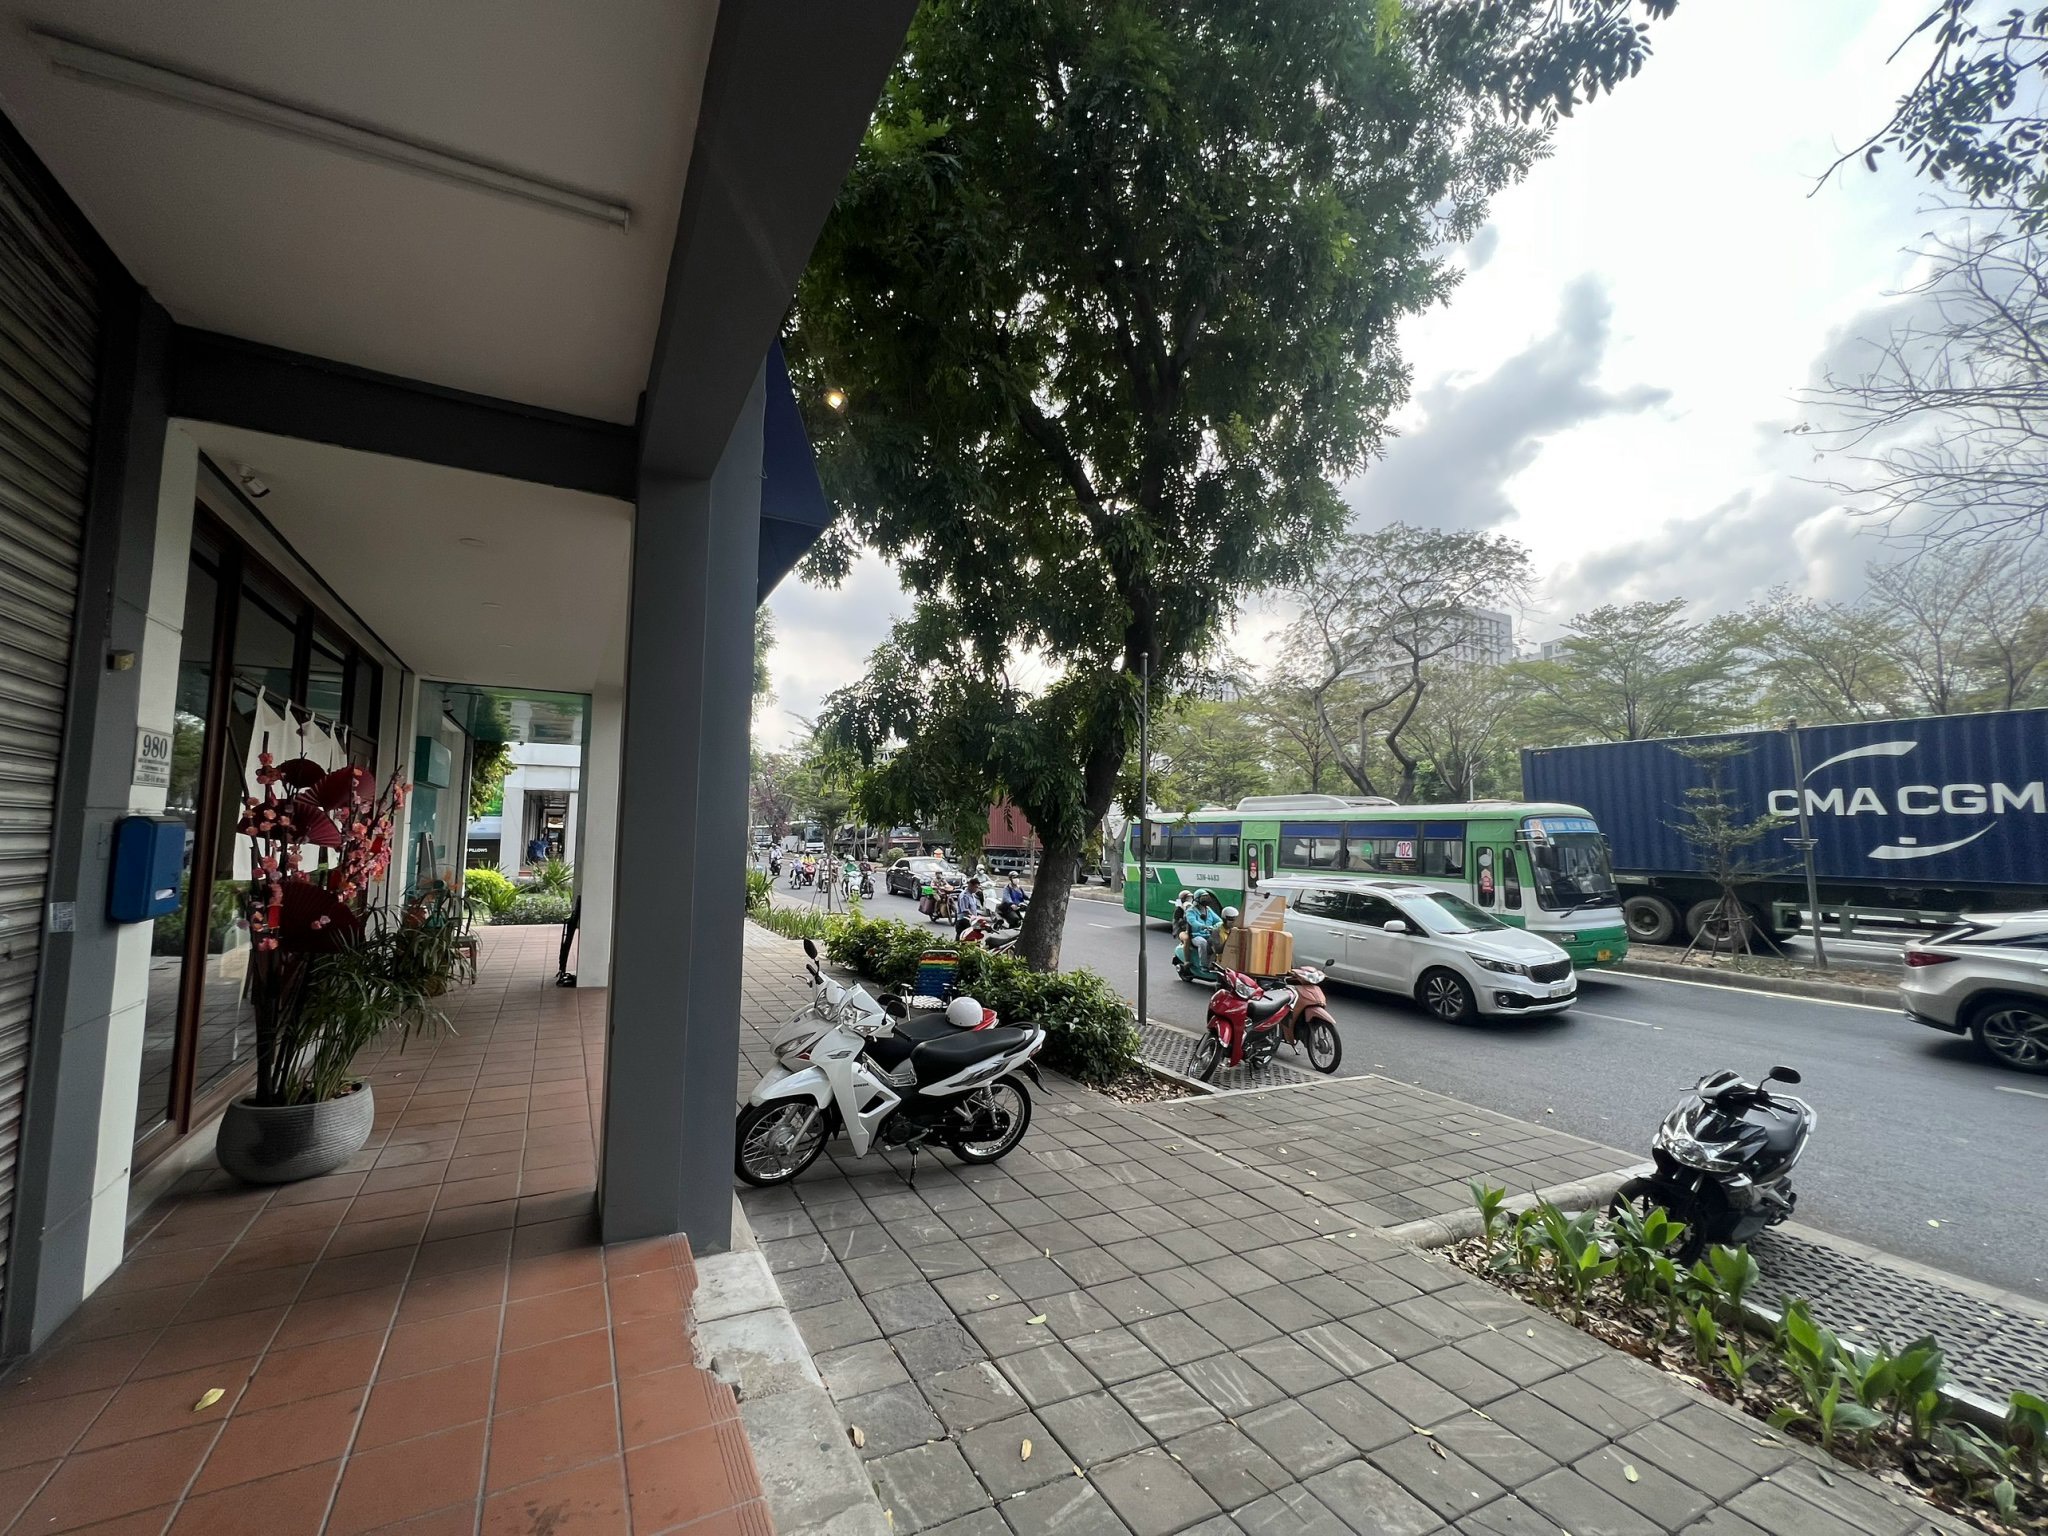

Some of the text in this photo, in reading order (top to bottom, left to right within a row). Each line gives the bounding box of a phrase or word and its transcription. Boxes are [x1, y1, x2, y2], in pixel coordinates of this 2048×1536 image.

[142, 734, 168, 760] 980
[1767, 781, 2047, 816] CMA CGM
[1397, 842, 1411, 857] 102
